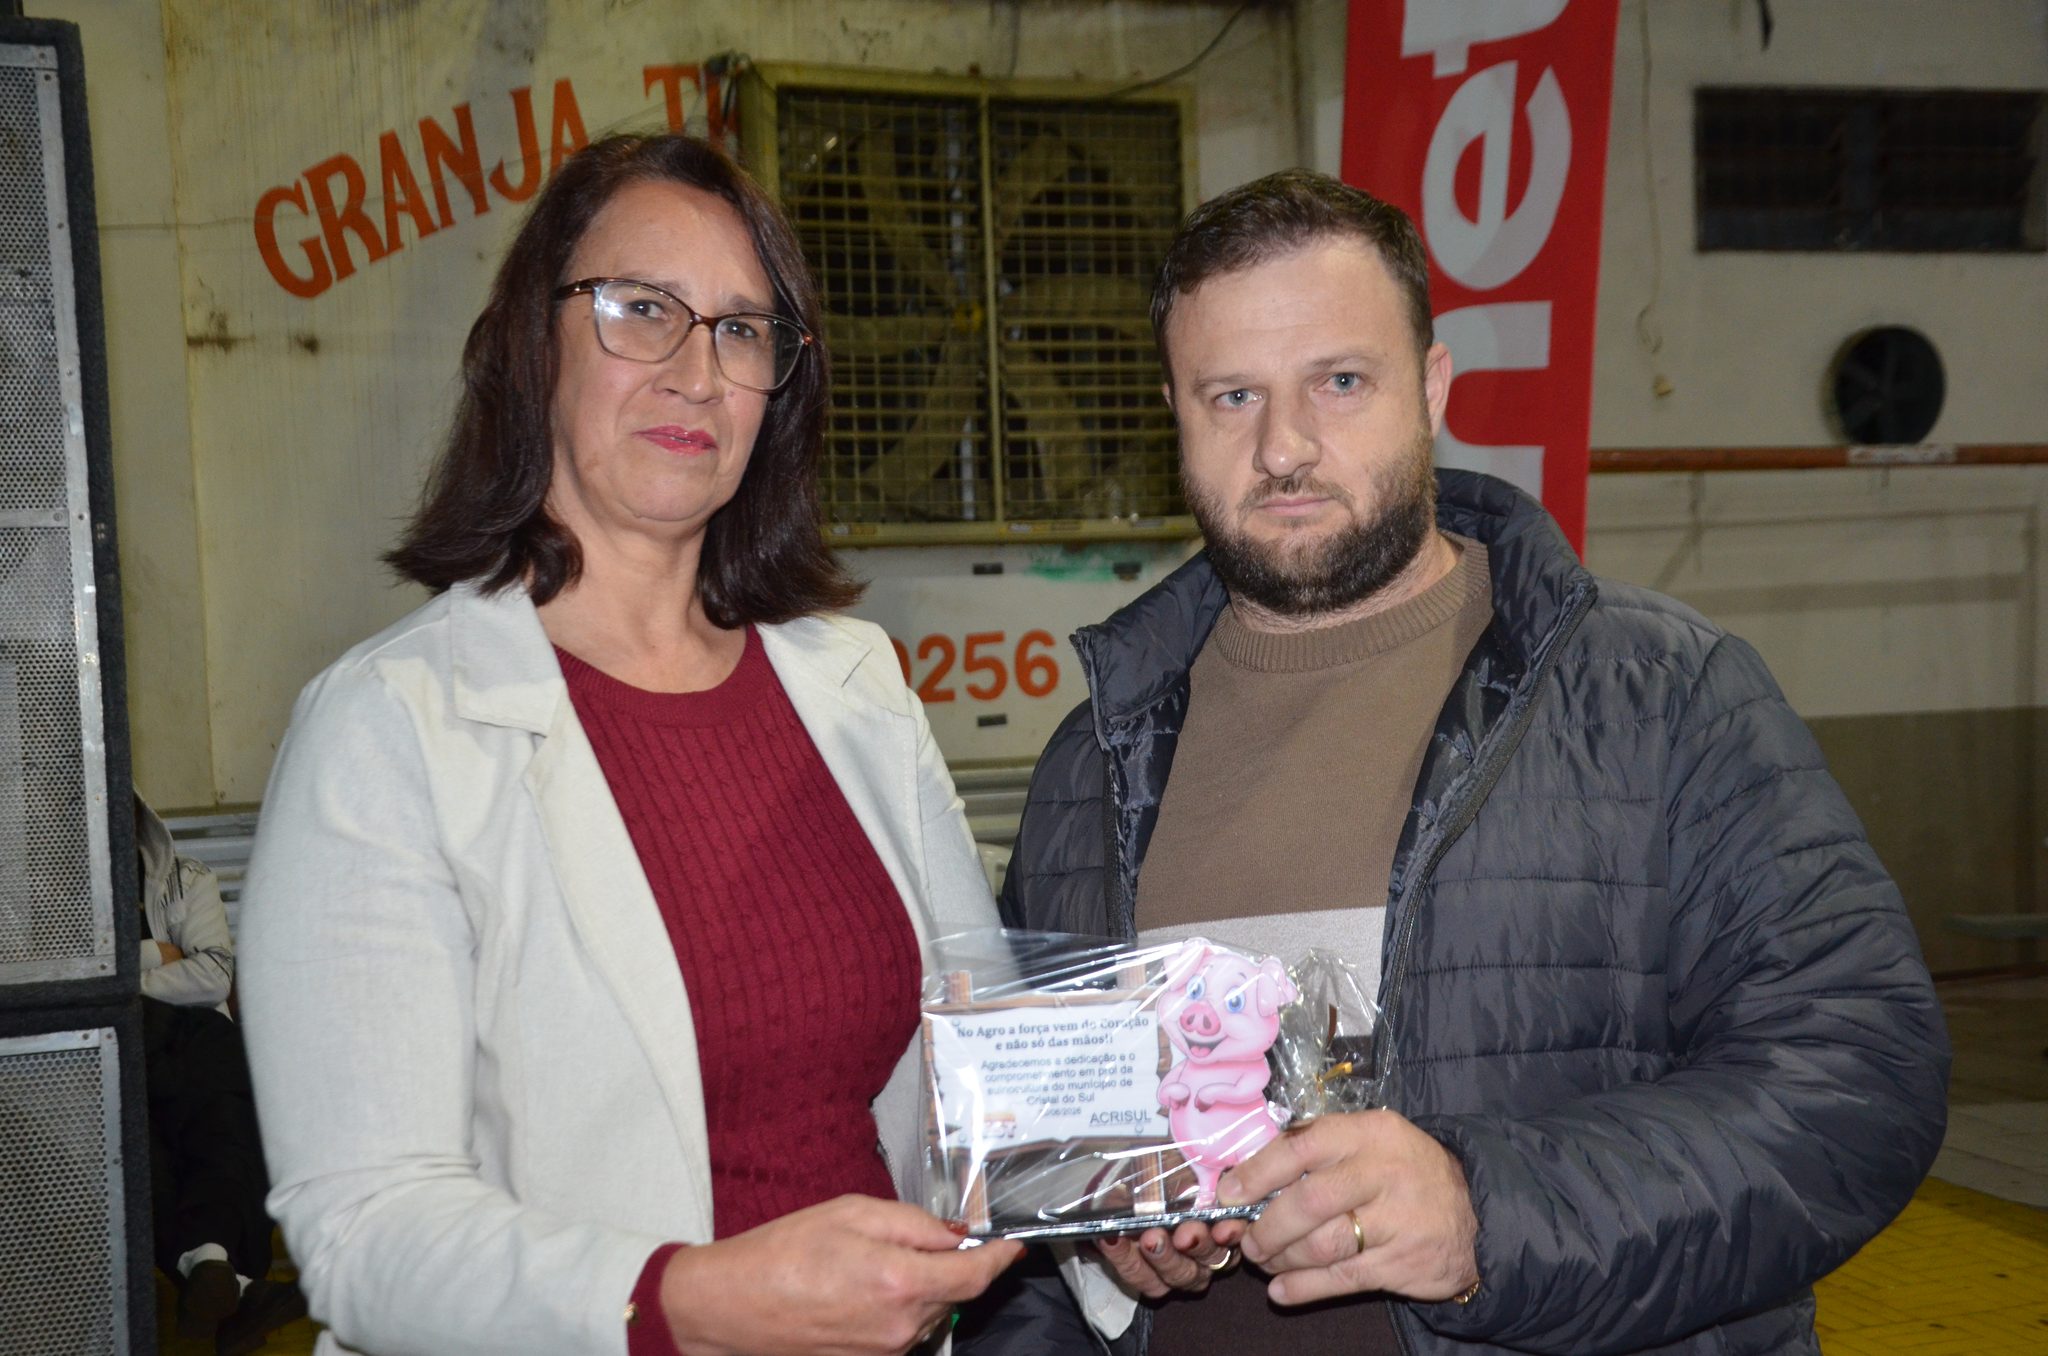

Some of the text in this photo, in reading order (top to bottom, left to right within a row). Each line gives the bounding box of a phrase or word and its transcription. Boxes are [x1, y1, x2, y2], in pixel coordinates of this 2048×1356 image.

[253, 77, 590, 299] GRANJA
[976, 1026, 1006, 1039] Agro
[1009, 1026, 1015, 1034] a
[1019, 1023, 1049, 1035] força
[1053, 1022, 1078, 1031] vem
[995, 1042, 1002, 1050] e
[1006, 1039, 1028, 1050] não
[1031, 1037, 1045, 1048] só
[1048, 1036, 1068, 1047] das
[981, 1057, 1051, 1071] Agradecemos
[1064, 1053, 1116, 1065] dedicação
[1119, 1053, 1126, 1061] e
[1128, 1052, 1136, 1061] o
[1079, 1068, 1095, 1077] em
[1098, 1065, 1117, 1077] prol
[1120, 1064, 1133, 1074] da
[1052, 1081, 1065, 1091] do
[1068, 1077, 1117, 1090] município
[1120, 1077, 1133, 1087] de
[1026, 1092, 1095, 1105] Cristal do Sul
[1089, 1109, 1152, 1124] ACRISUL
